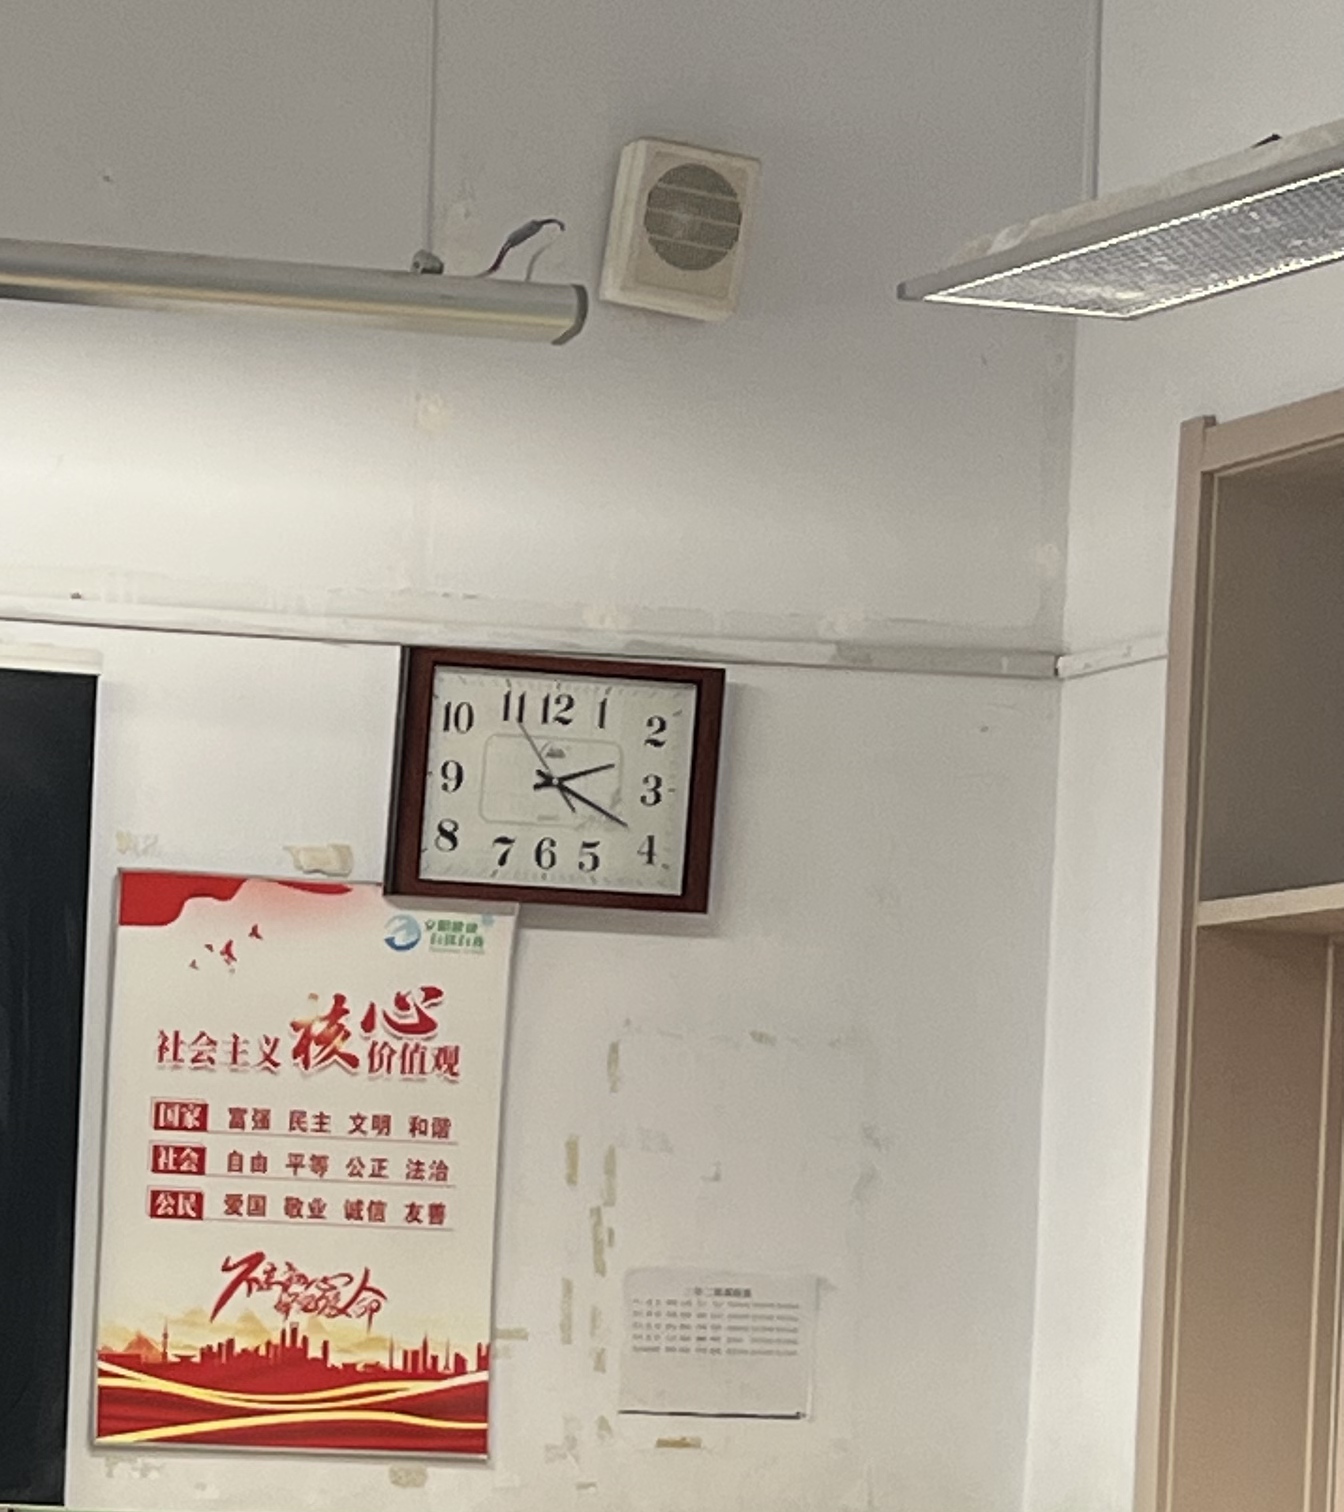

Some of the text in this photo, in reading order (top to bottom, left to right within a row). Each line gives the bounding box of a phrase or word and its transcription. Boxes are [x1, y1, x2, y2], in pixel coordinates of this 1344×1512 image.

[443, 702, 473, 734] 10
[503, 690, 525, 723] 11
[541, 693, 575, 725] 12
[598, 698, 608, 729] 1
[644, 716, 667, 747] 2
[441, 760, 464, 793] 9
[640, 774, 663, 806] 3
[435, 818, 459, 852] 8
[637, 835, 657, 865] 4
[493, 836, 515, 867] 7
[534, 837, 557, 869] 6
[578, 841, 600, 872] 5
[158, 1104, 452, 1139] 国家 富强 民主 文明 和谐
[157, 1147, 450, 1183] 社会 自由 平等 公正 法治
[155, 1193, 446, 1226] 公民 爱国 敬业 诚信 友善
